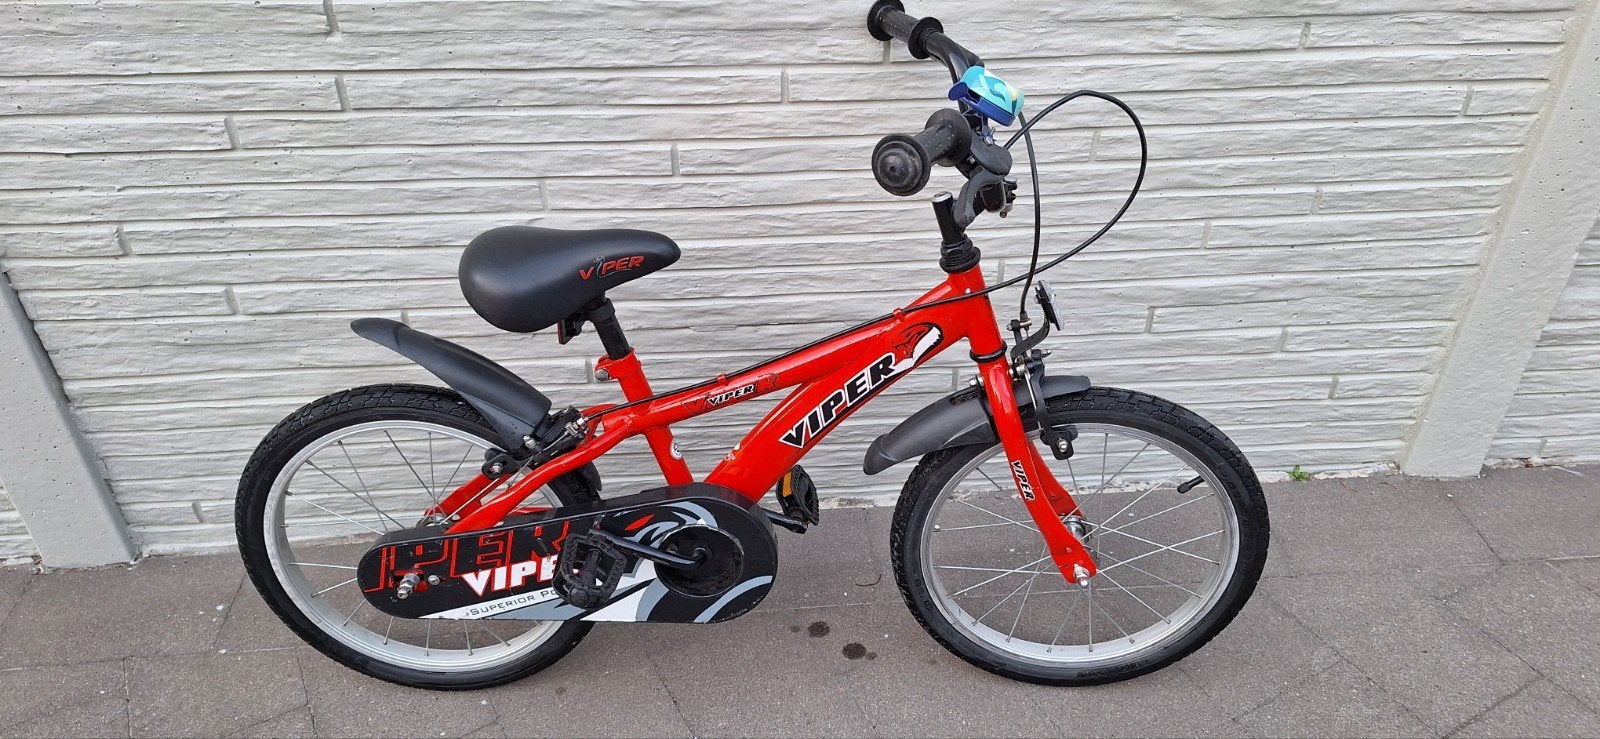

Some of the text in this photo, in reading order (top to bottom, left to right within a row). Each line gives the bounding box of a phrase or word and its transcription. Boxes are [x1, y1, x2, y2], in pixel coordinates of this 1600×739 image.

[579, 255, 645, 280] VIPER
[707, 384, 755, 406] VIPER
[778, 352, 897, 449] VIPER
[1010, 459, 1036, 501] VIPER
